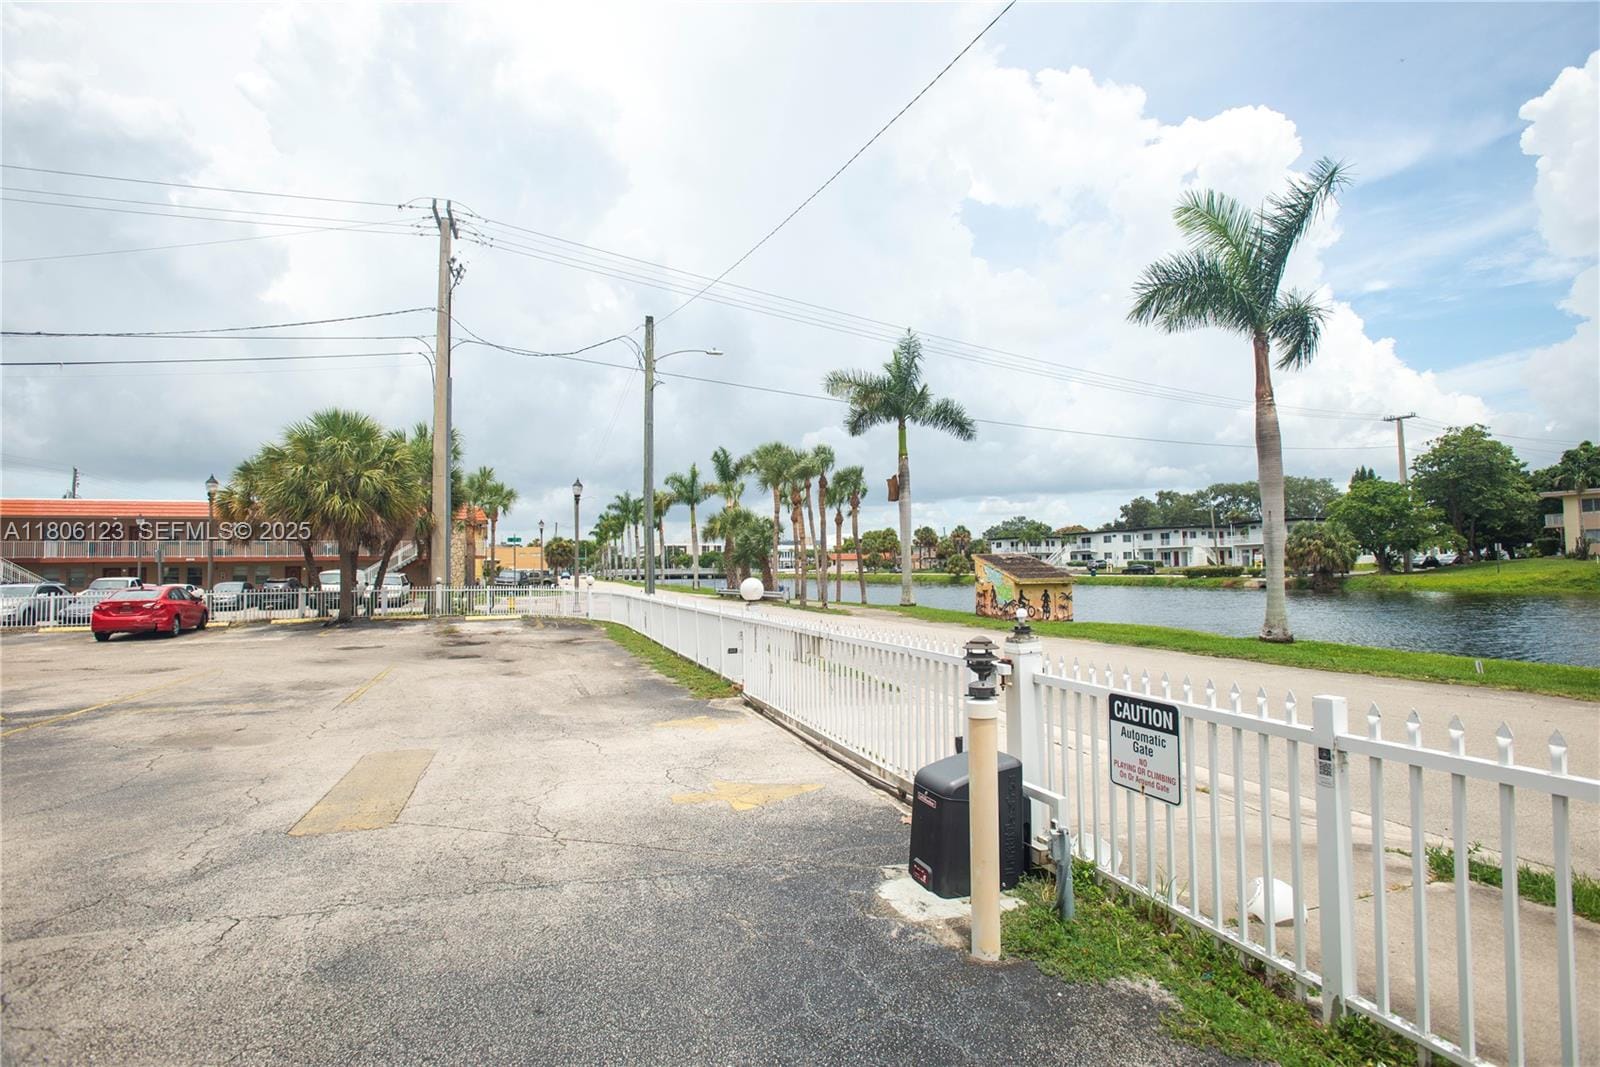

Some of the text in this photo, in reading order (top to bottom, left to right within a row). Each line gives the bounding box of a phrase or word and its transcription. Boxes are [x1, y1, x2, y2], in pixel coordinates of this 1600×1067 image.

[1114, 700, 1173, 730] CAUTION
[1121, 726, 1167, 748] Automatic
[1133, 741, 1154, 757] Gate
[1139, 758, 1148, 767] NO
[1113, 759, 1177, 786] PLAYING OR CLIMBING
[1156, 782, 1170, 793] Gate
